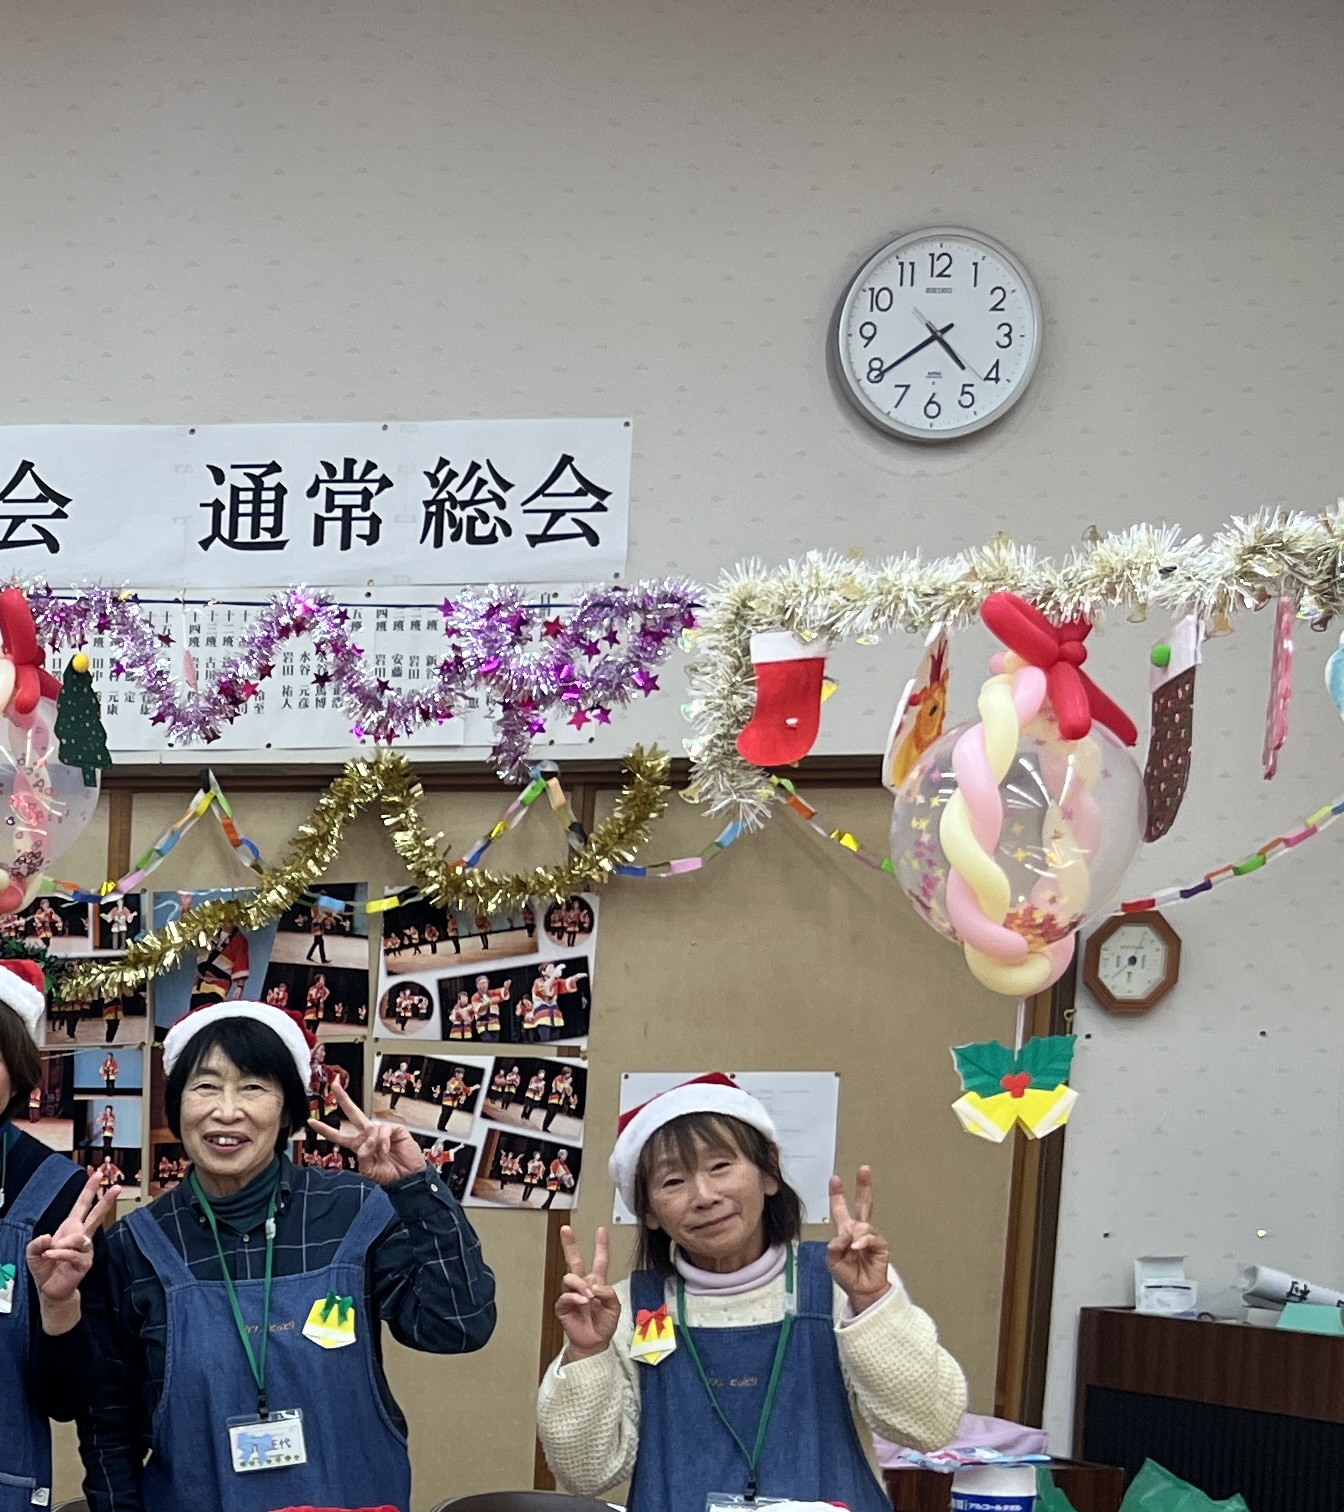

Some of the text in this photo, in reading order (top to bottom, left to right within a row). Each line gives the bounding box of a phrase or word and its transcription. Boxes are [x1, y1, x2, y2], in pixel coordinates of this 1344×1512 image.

[898, 261, 915, 287] 11
[929, 253, 953, 278] 12
[972, 262, 979, 287] 1
[868, 287, 893, 312] 10
[989, 286, 1007, 312] 2
[859, 321, 877, 348] 9
[996, 322, 1013, 349] 3
[867, 357, 884, 384] 8
[983, 359, 1001, 384] 4
[894, 384, 911, 409] 7
[923, 392, 941, 419] 6
[958, 383, 976, 409] 5
[197, 453, 612, 552] 通常総会
[375, 608, 388, 631] 四班
[299, 651, 311, 676] 水谷
